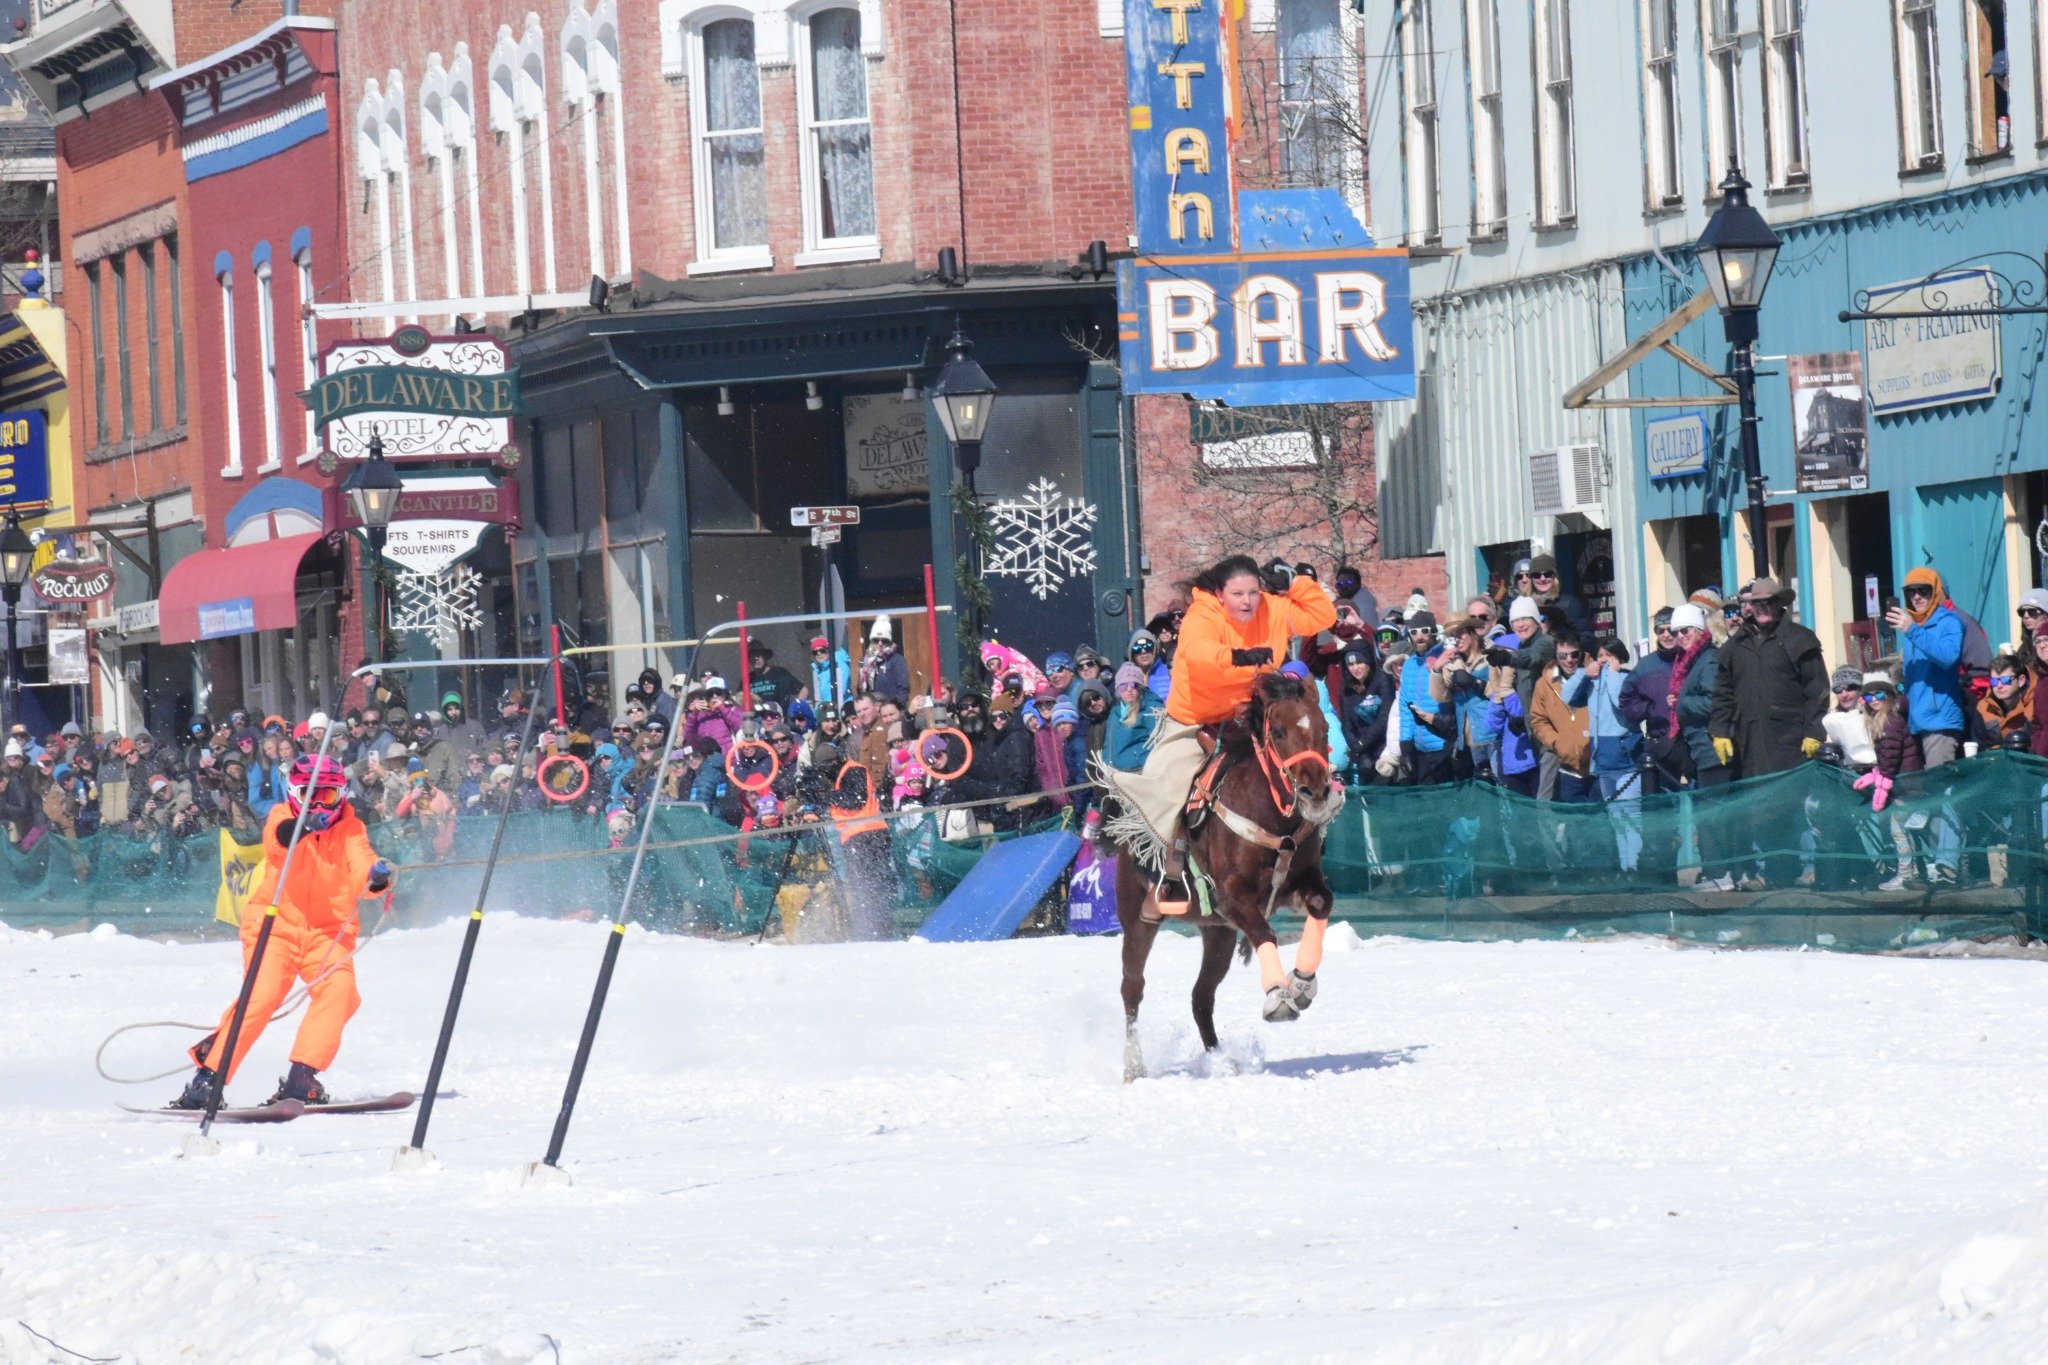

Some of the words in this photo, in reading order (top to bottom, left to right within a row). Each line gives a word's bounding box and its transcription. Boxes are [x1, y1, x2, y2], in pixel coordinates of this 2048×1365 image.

[1145, 270, 1399, 372] BAR
[1869, 317, 1897, 350] ART
[1916, 300, 1992, 342] FRAMING
[1798, 374, 1832, 384] DELAWARE
[1832, 372, 1854, 383] HOTEL
[320, 371, 514, 418] DELAWARE
[357, 418, 434, 437] HOTEL
[1651, 427, 1699, 462] GALLERY
[1815, 462, 1829, 471] 1886
[346, 492, 499, 518] MCANTILE
[809, 511, 817, 520] E
[822, 508, 842, 521] 7th
[846, 510, 857, 519] St
[388, 530, 409, 541] FTS
[416, 529, 470, 540] T-SHIRTS
[392, 544, 456, 556] SOUVENIRS
[41, 578, 86, 598] ROCK
[84, 573, 110, 597] HUT
